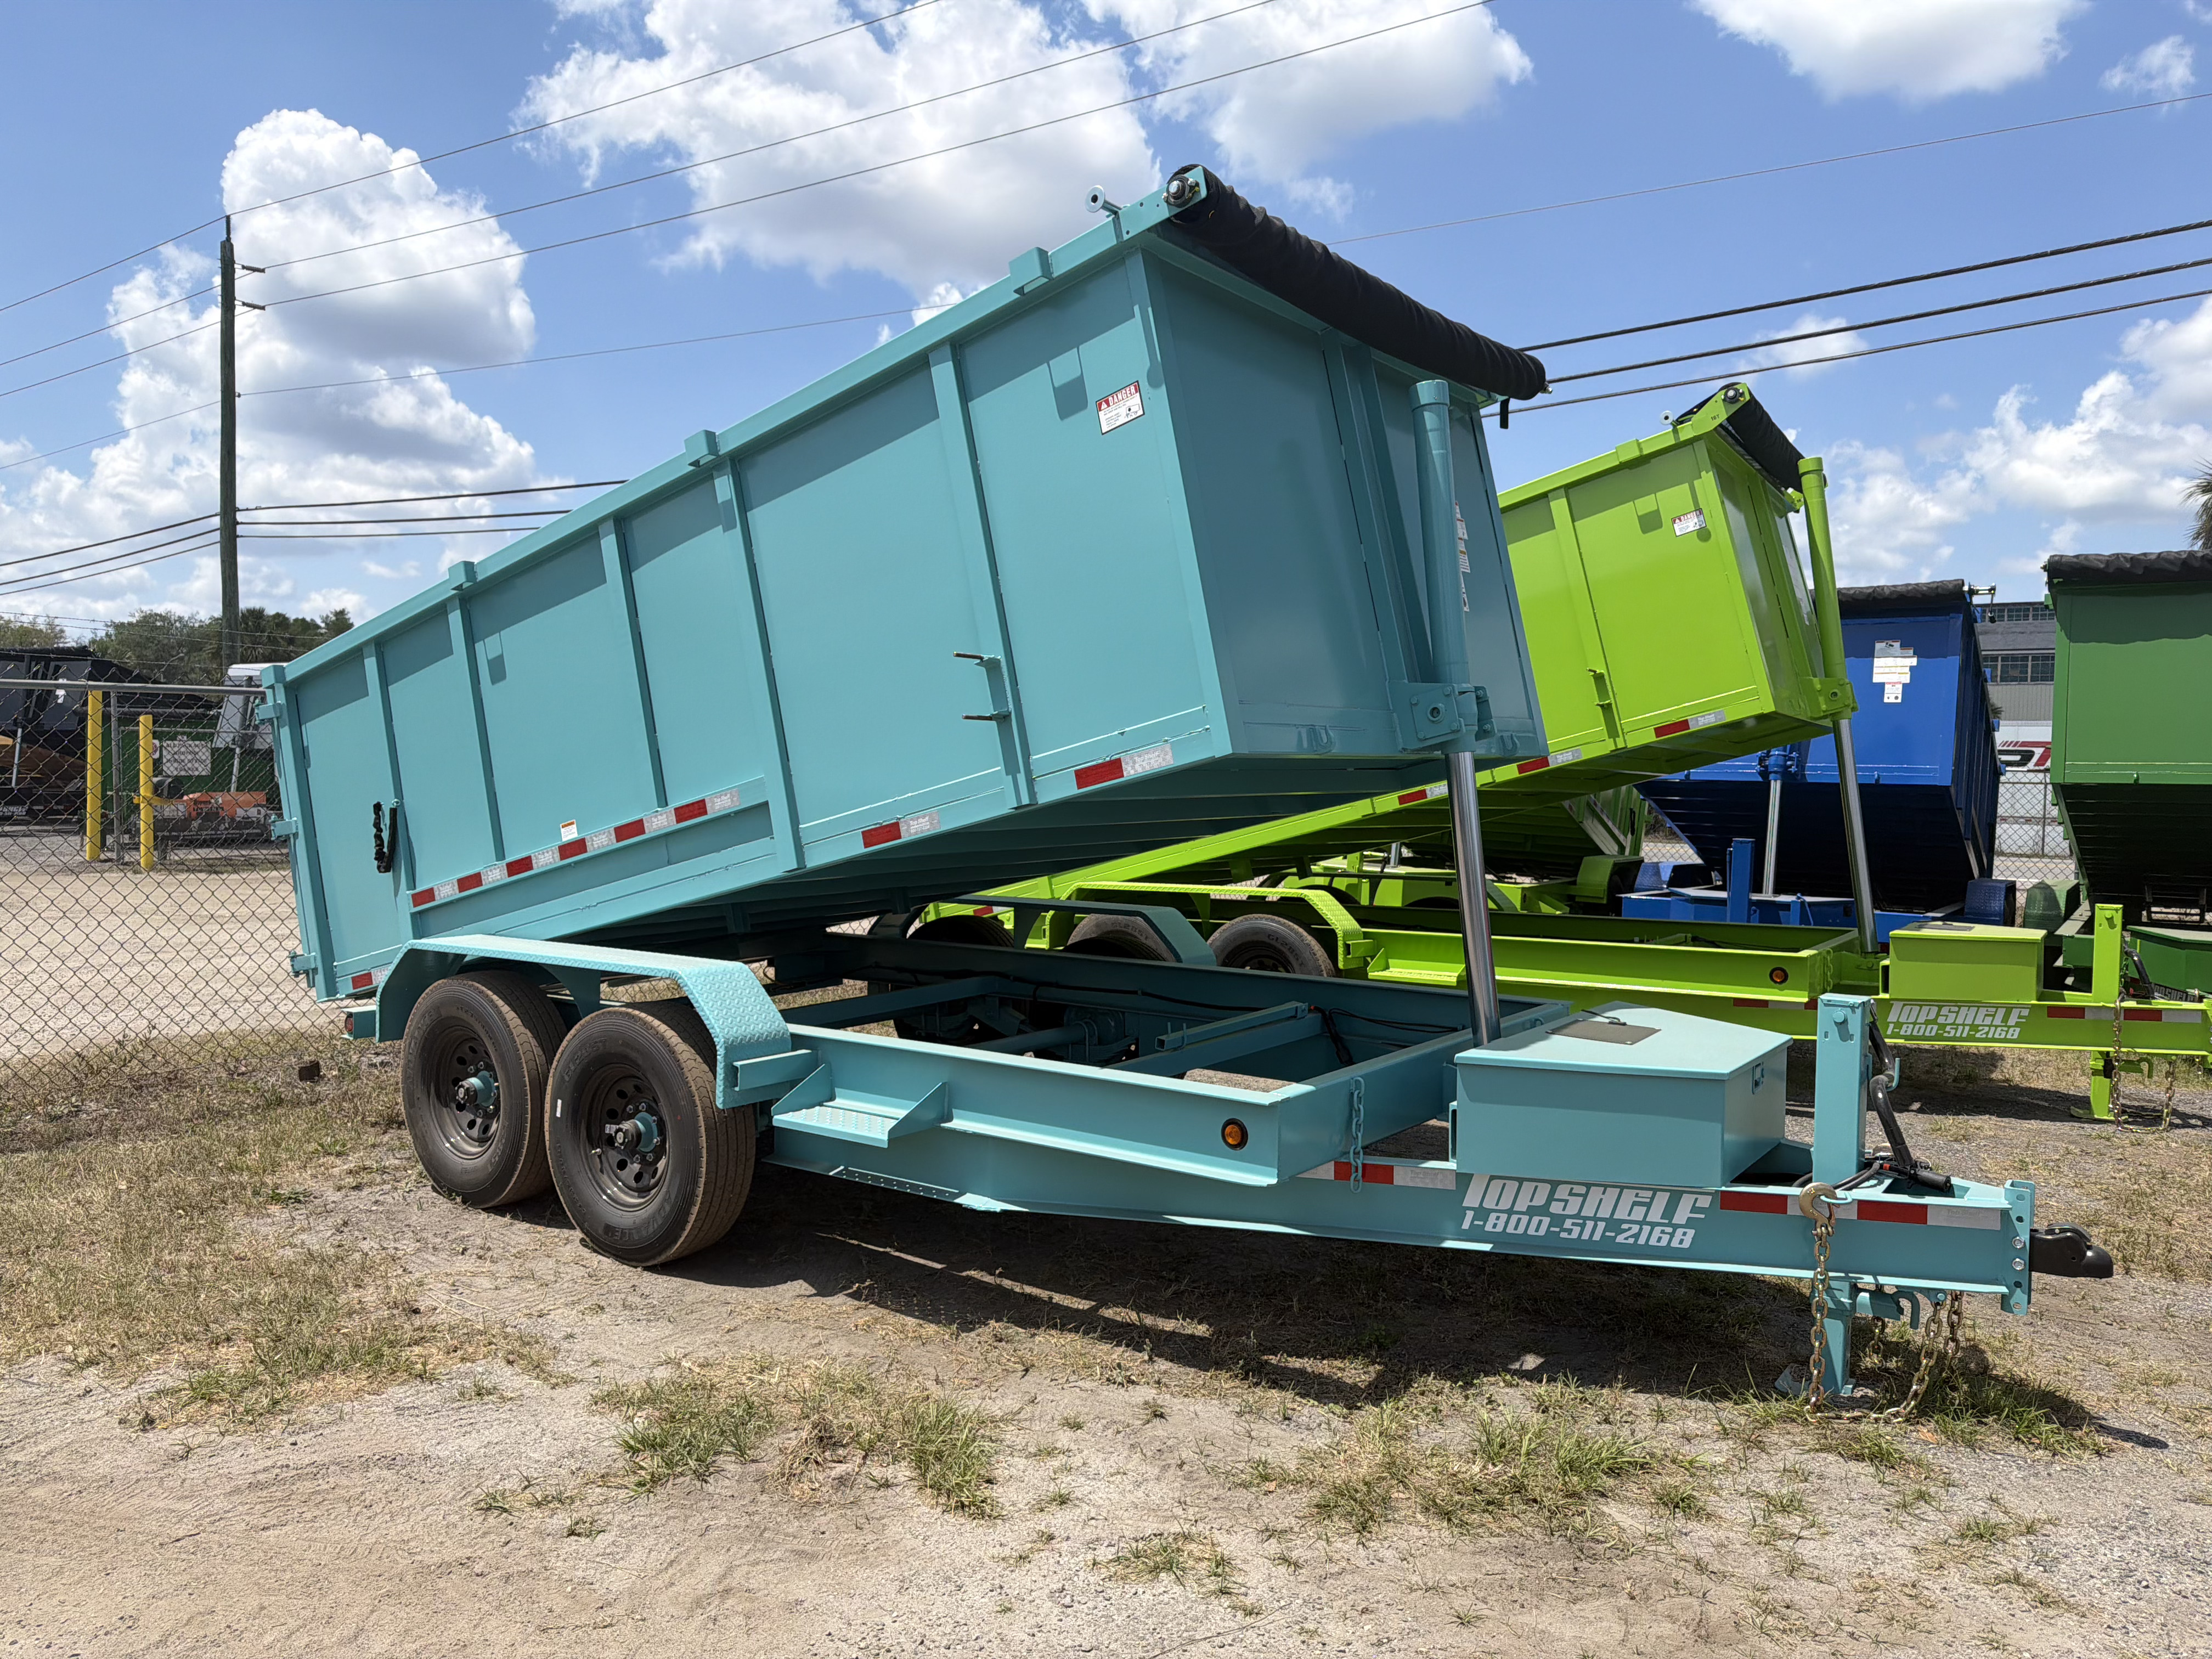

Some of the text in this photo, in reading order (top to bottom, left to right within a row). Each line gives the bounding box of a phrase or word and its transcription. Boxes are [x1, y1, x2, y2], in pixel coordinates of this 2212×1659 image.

[1108, 386, 1136, 406] DANGER
[1680, 510, 1700, 522] DANGER
[1145, 751, 1160, 759] Shelf
[1886, 1024, 2021, 1039] 1-800-511-2168
[1461, 1210, 1696, 1249] 1-800-511-2168
